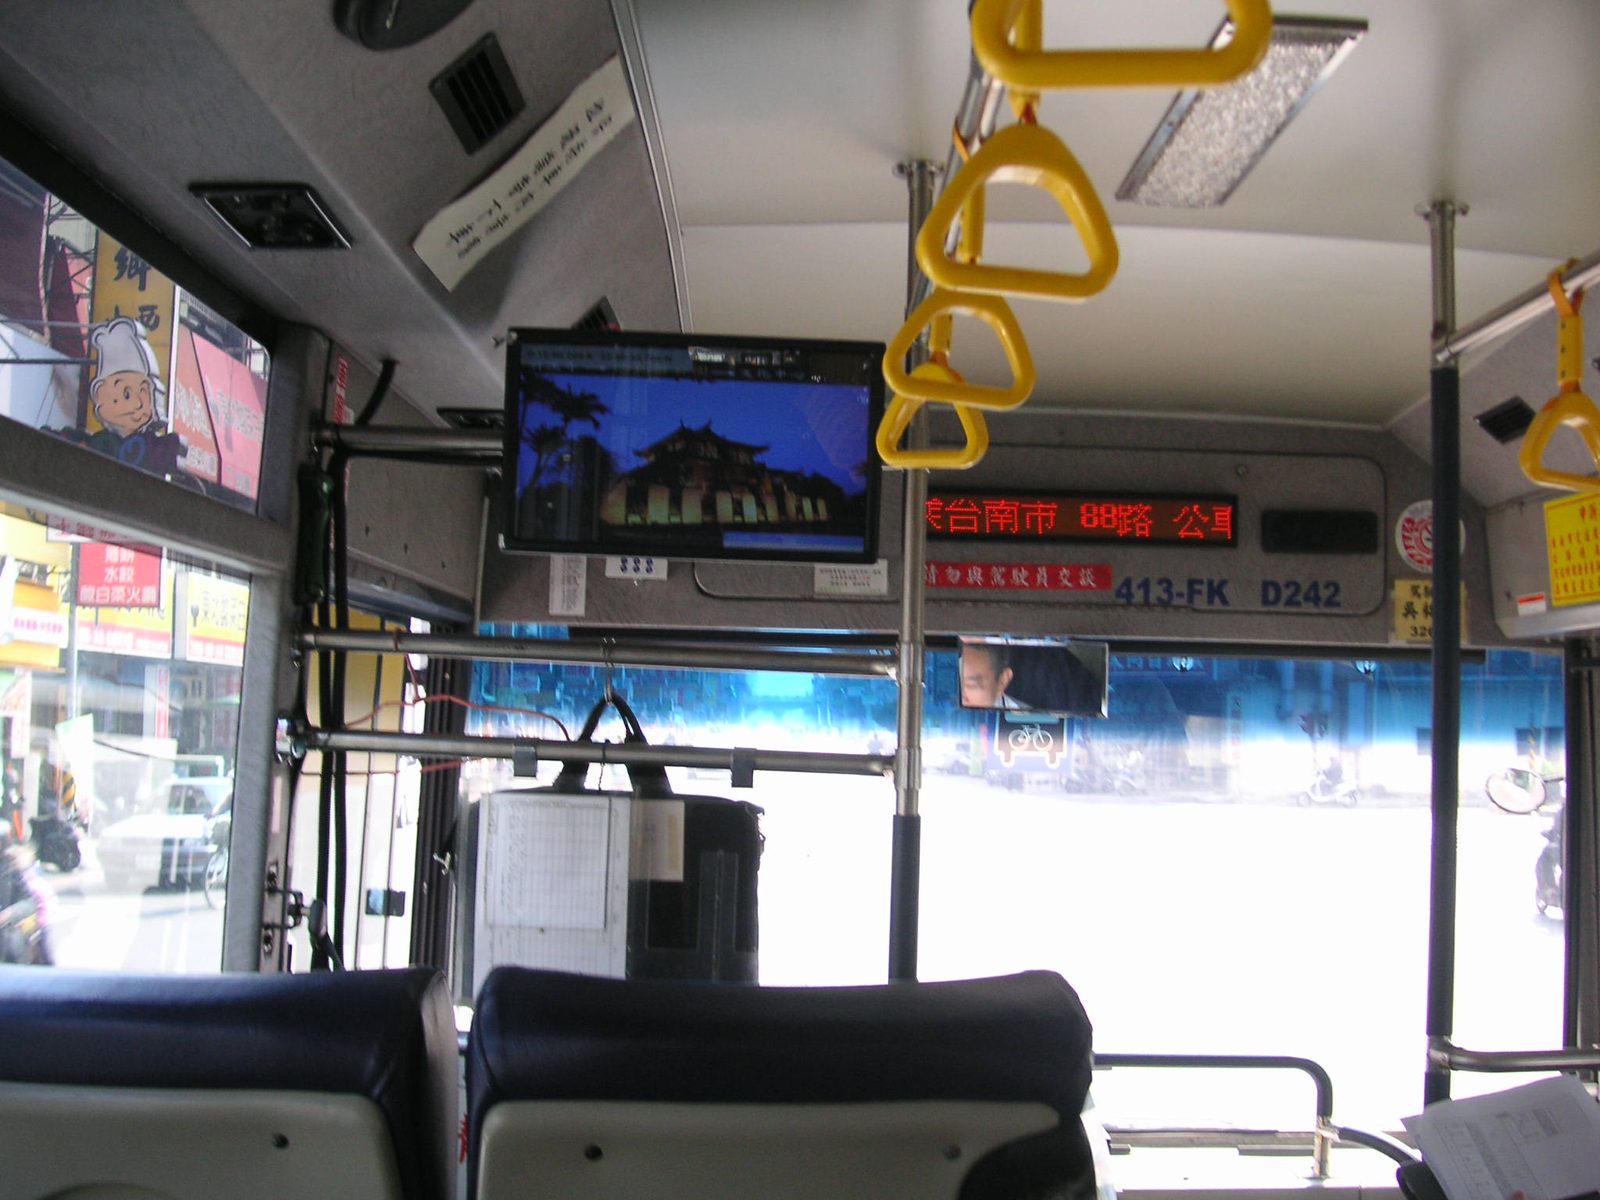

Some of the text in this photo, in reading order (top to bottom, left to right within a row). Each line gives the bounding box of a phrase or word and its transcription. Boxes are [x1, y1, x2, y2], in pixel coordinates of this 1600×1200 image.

[1080, 503, 1152, 538] 88路
[1115, 577, 1230, 607] 413-FK
[1261, 580, 1342, 607] D242
